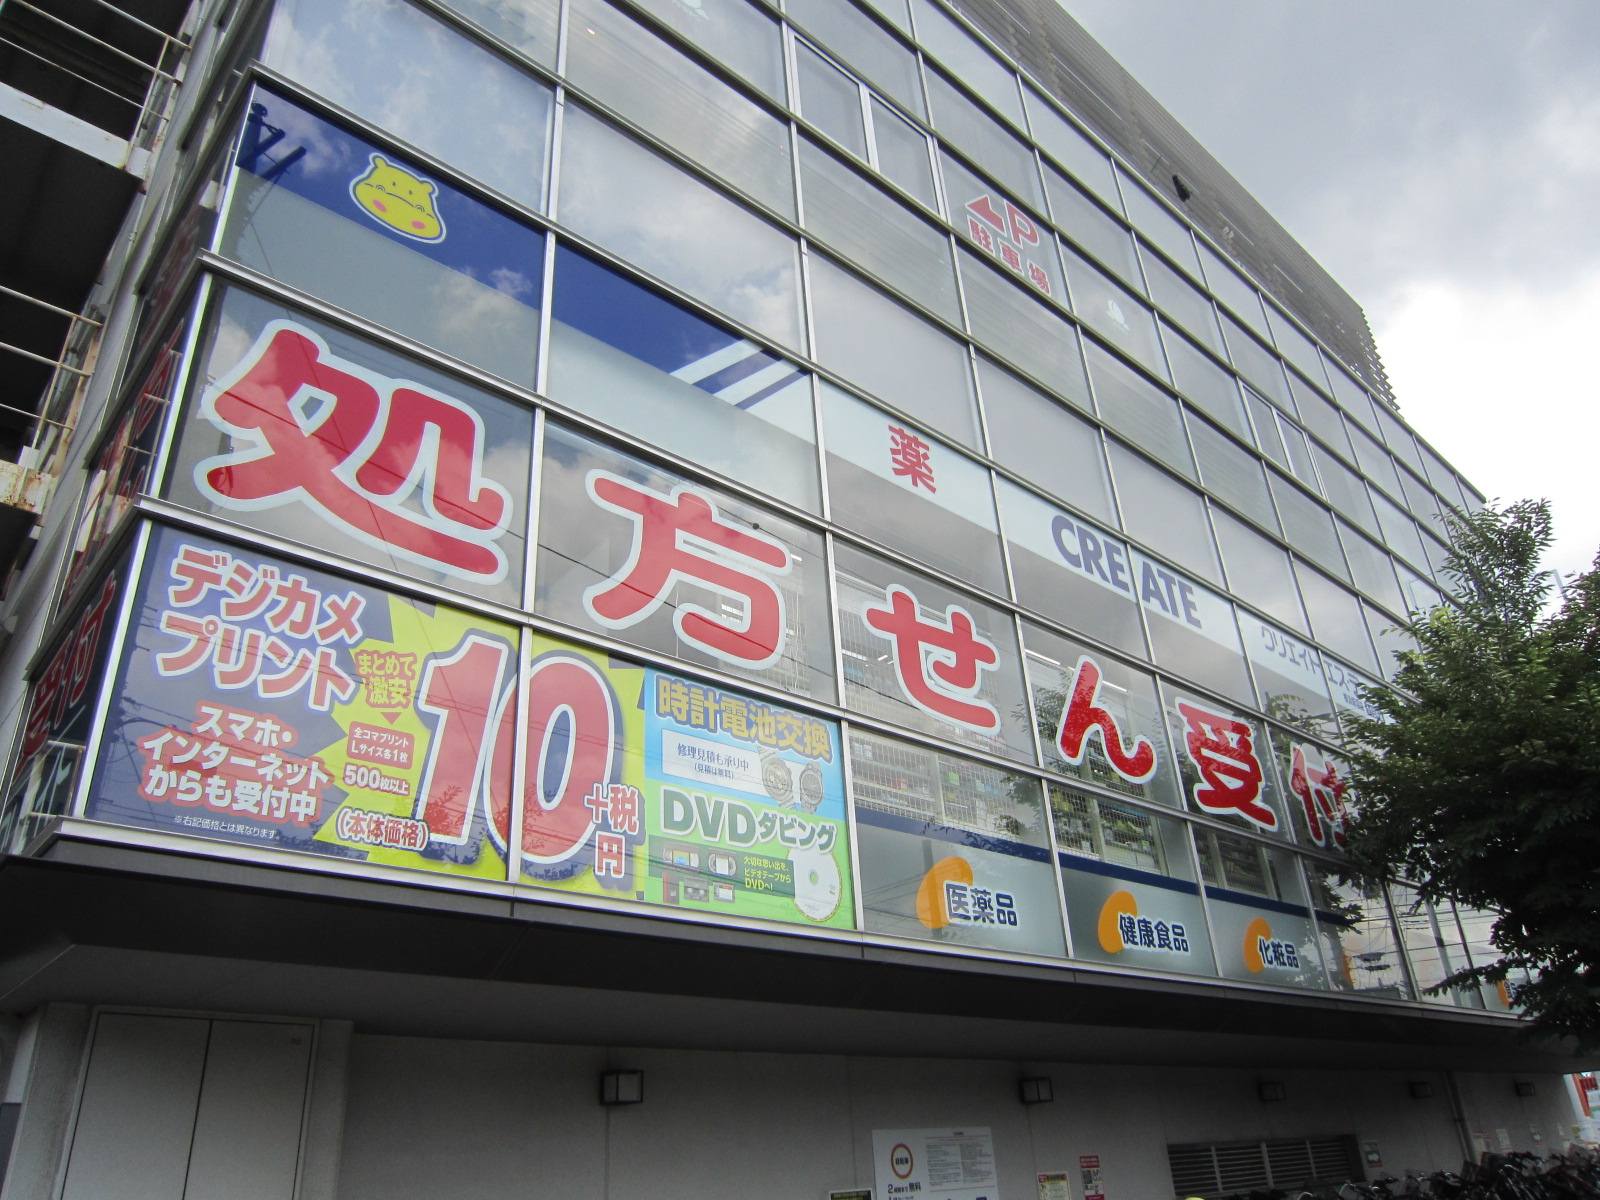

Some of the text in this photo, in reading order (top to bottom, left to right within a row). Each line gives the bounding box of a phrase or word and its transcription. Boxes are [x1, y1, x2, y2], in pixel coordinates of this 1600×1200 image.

[1003, 198, 1040, 248] P
[966, 214, 1052, 297] 駐車場
[888, 424, 937, 495] 薬
[168, 543, 367, 646] デジカメ
[1051, 514, 1203, 630] CREATE
[156, 609, 356, 713] プリント
[356, 652, 416, 678] まとめて
[367, 677, 411, 706] 激安
[352, 726, 409, 748] 全コマプリント
[656, 676, 832, 760] 時計電池交換
[143, 731, 330, 790] インターネット
[351, 740, 409, 764] Lサイズ各1枚
[417, 632, 619, 866] 10
[677, 742, 749, 772] 修理見積も承り中
[144, 763, 318, 823] からも受付中
[344, 763, 411, 797] 500枚以上
[337, 806, 430, 851] (本体価格)
[662, 787, 836, 851] DVDダビング
[595, 832, 626, 878] 円
[743, 867, 792, 884] ビデオテープから
[945, 882, 1018, 927] 医薬品
[1118, 913, 1189, 954] 健康食品
[1257, 937, 1301, 969] 化粧品
